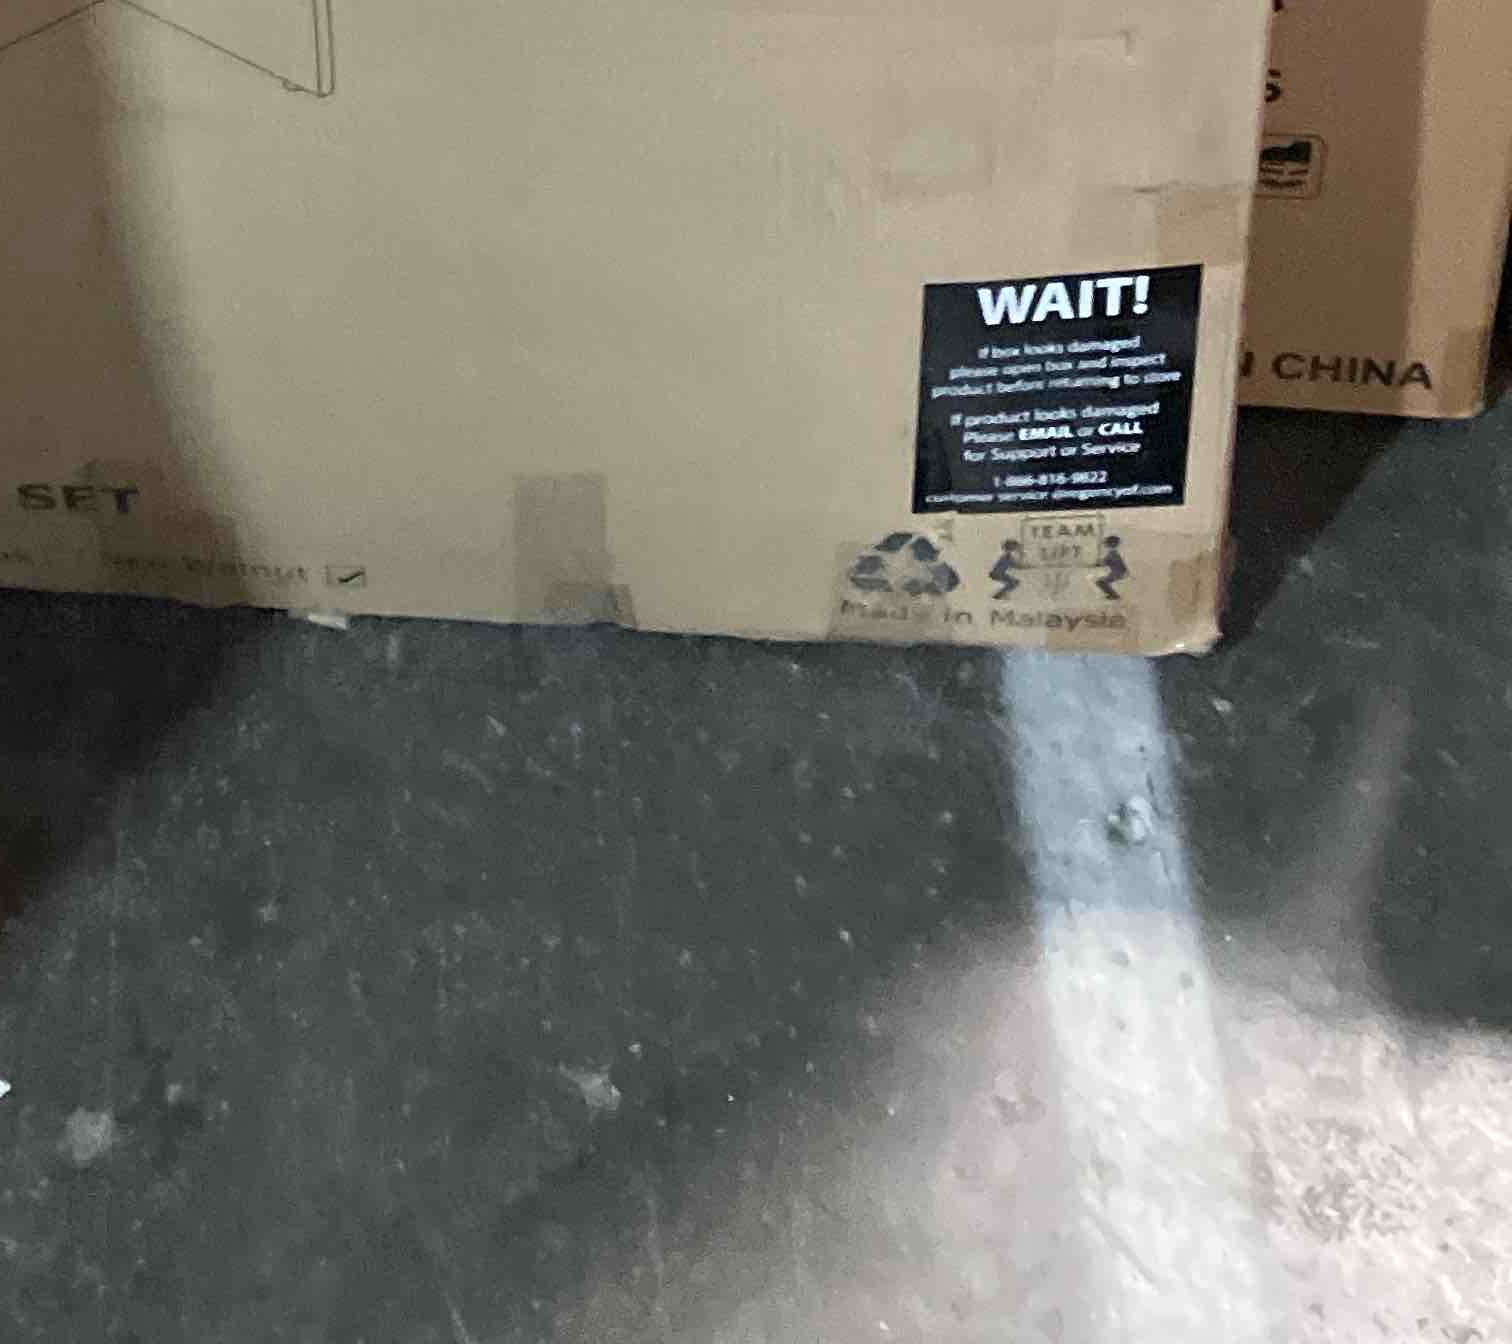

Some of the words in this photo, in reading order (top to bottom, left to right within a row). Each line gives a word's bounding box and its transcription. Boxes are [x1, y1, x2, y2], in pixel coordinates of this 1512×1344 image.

[976, 275, 1151, 327] WAIT!
[1066, 336, 1142, 354] damaged
[1123, 373, 1141, 385] to
[1272, 351, 1433, 390] CHINA
[963, 411, 1031, 428] product
[1079, 401, 1161, 419] damaged
[1017, 425, 1074, 440] EMAIL
[1097, 421, 1144, 436] CALL
[962, 449, 985, 462] for
[989, 445, 1057, 461] Support
[1080, 441, 1142, 456] Service
[15, 481, 141, 514] SET
[1030, 523, 1096, 540] TEAM
[1040, 544, 1084, 562] LIFT
[942, 610, 974, 626] in
[989, 609, 1129, 634] Malaysia
